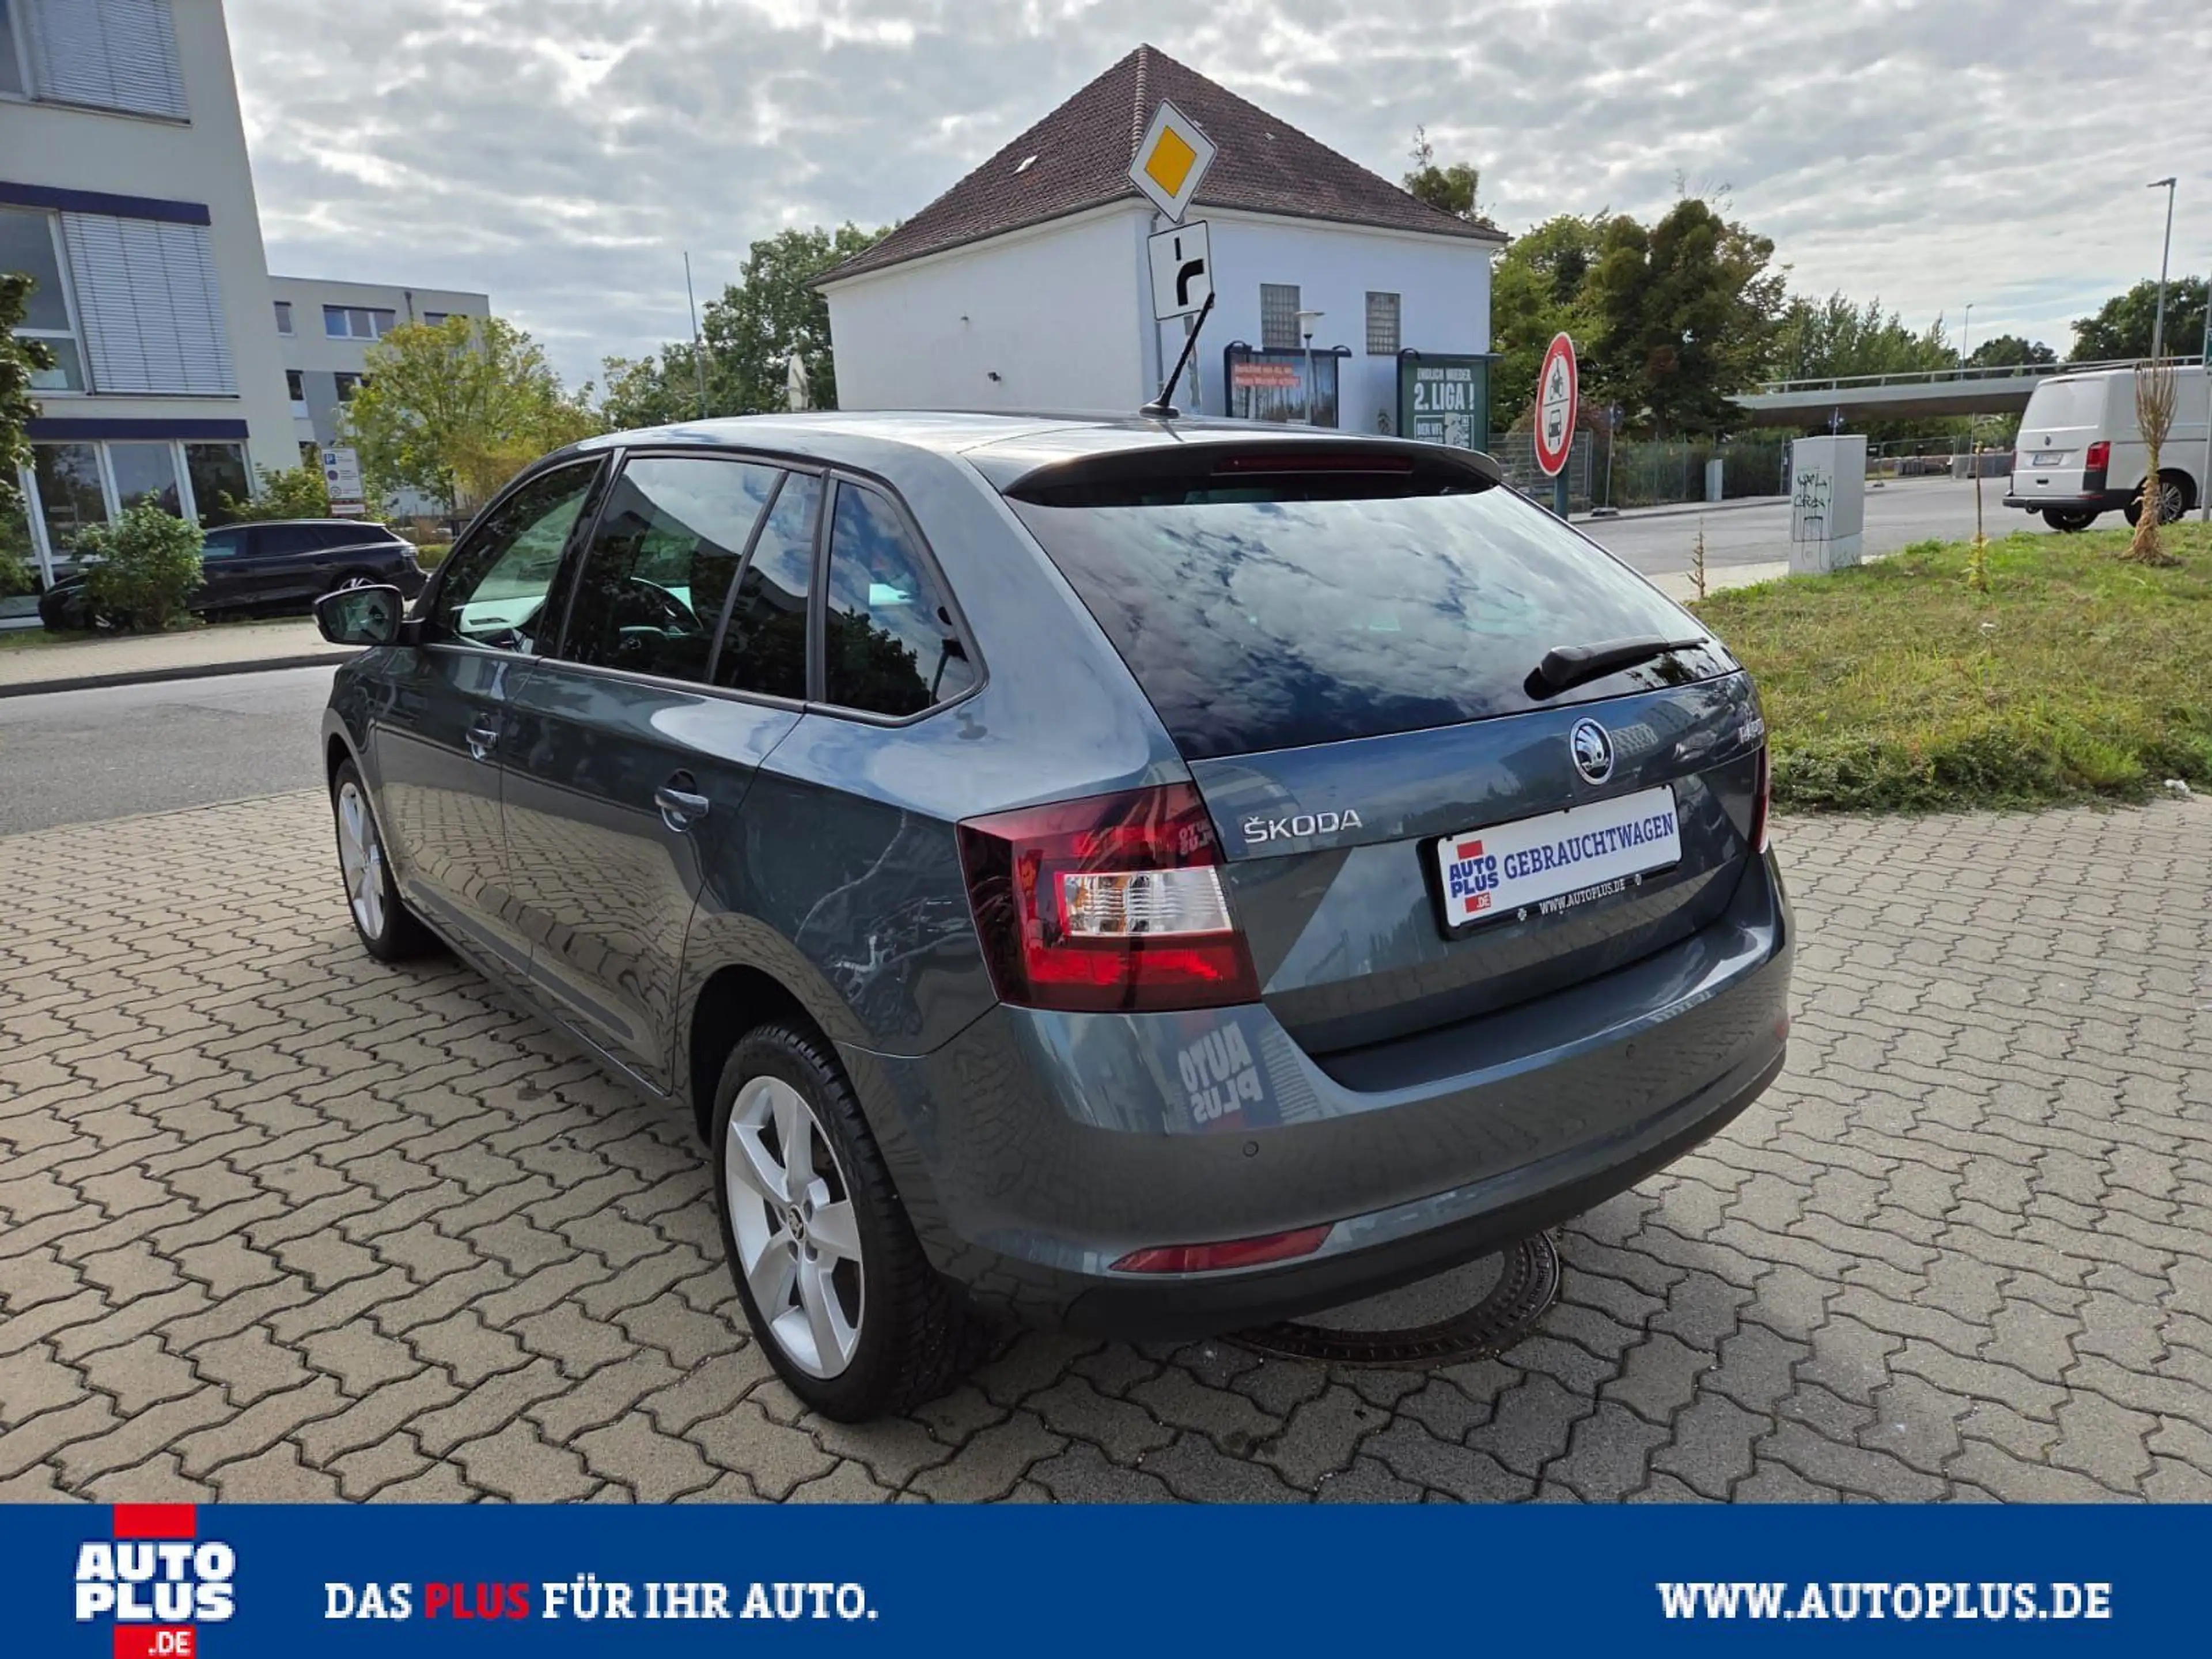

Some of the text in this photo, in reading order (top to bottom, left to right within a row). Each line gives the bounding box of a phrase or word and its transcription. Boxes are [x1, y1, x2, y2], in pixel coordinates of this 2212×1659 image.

[1414, 382, 1429, 410] 2.
[1432, 382, 1465, 410] LIGA
[1244, 809, 1363, 844] ŠKODA
[1503, 812, 1674, 879] GEBRAUCHTWAGEN
[1449, 855, 1497, 881] AUTO
[1450, 872, 1499, 898] PLUS
[1539, 878, 1626, 915] WWW.AUTOPLUS.DE
[1476, 894, 1491, 908] .DE
